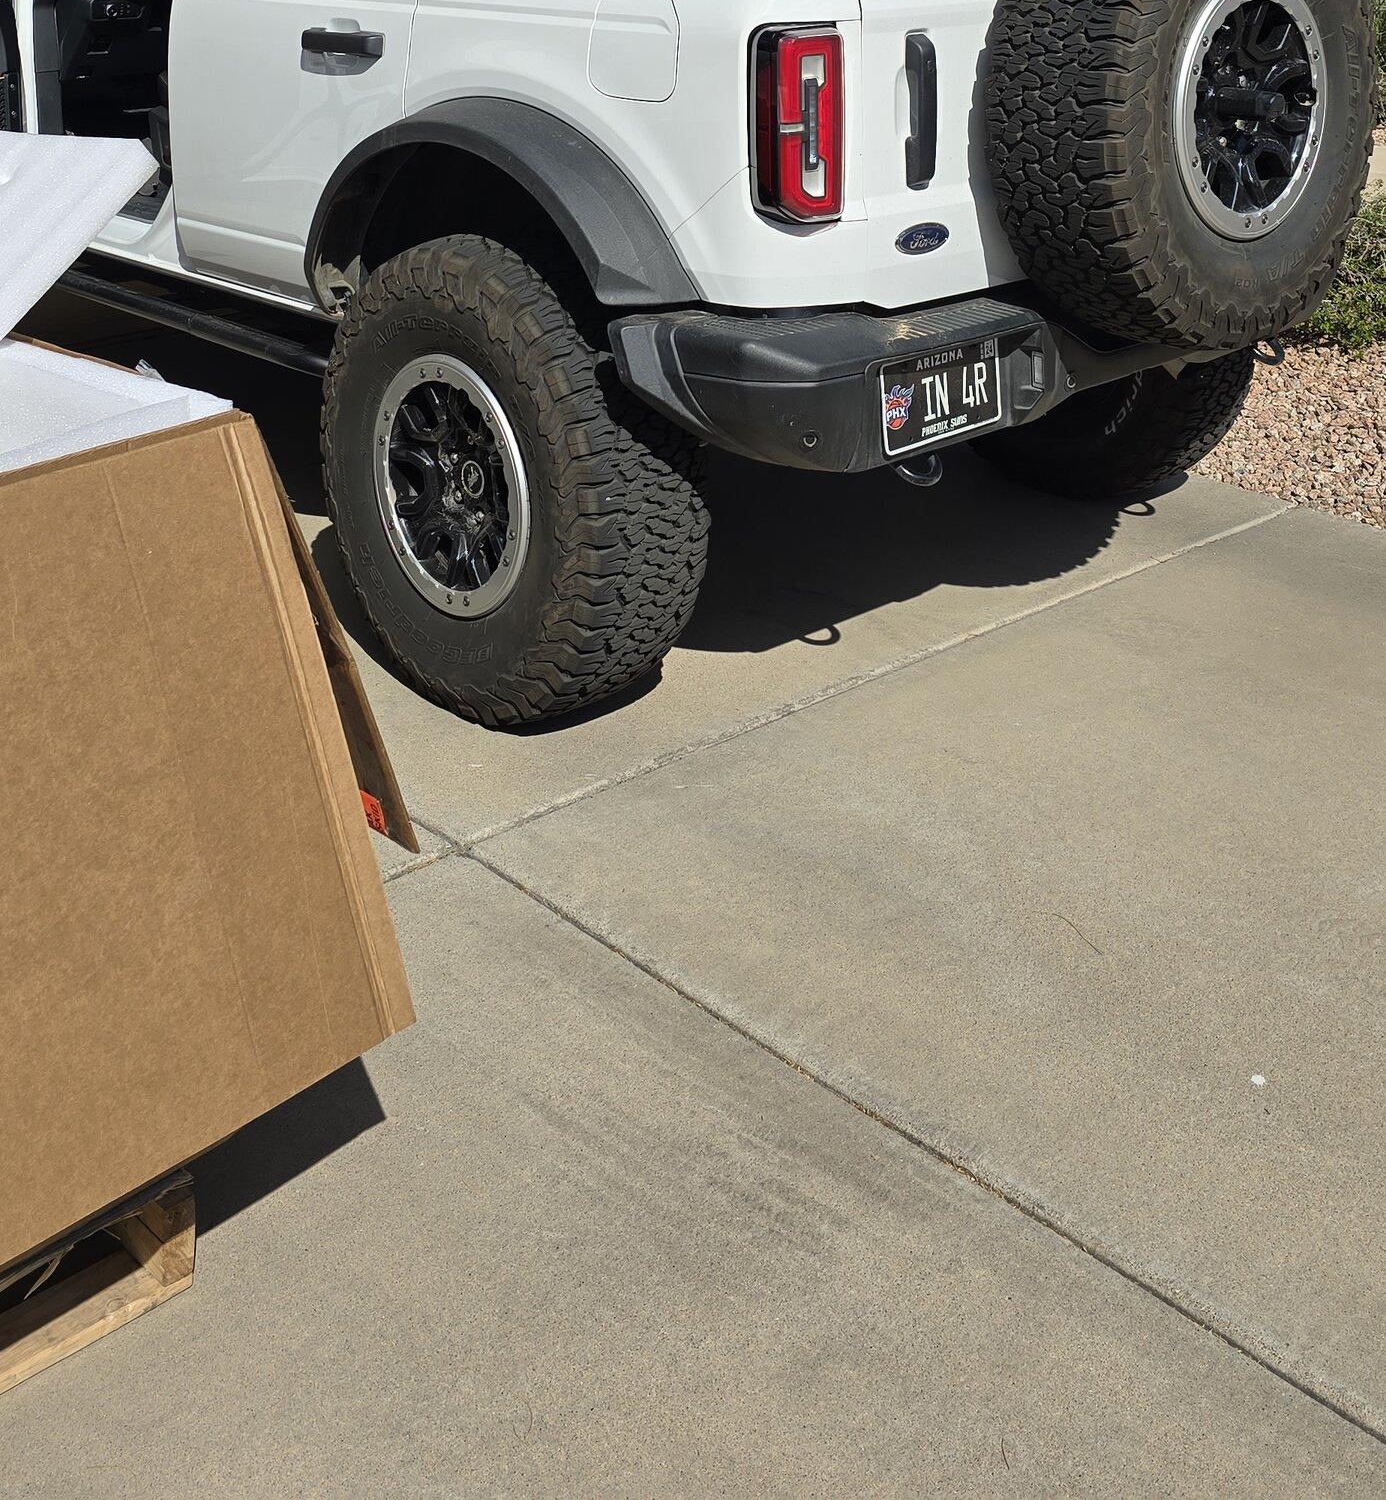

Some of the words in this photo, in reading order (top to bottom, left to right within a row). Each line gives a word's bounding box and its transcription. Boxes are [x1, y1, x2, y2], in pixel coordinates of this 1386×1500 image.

[910, 232, 939, 249] Ford
[916, 348, 964, 371] ARIZONA
[921, 372, 950, 422] IN
[962, 361, 989, 408] 4R
[886, 406, 907, 421] PHX
